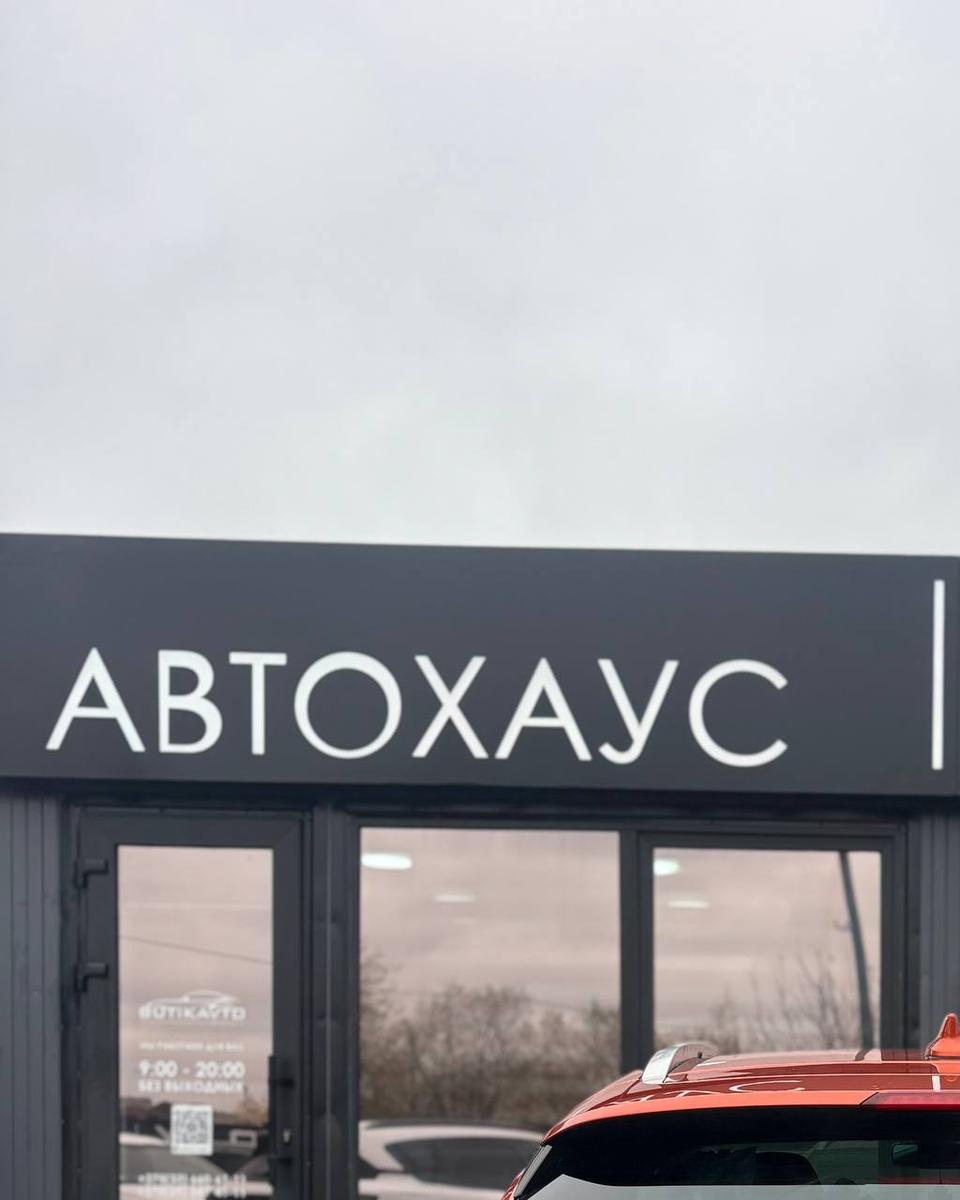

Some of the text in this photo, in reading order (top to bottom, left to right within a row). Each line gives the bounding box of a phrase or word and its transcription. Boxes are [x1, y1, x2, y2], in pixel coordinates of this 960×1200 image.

[46, 647, 789, 767] АВТОХАУС
[138, 1060, 178, 1078] 9:00
[195, 1061, 246, 1079] 20:00
